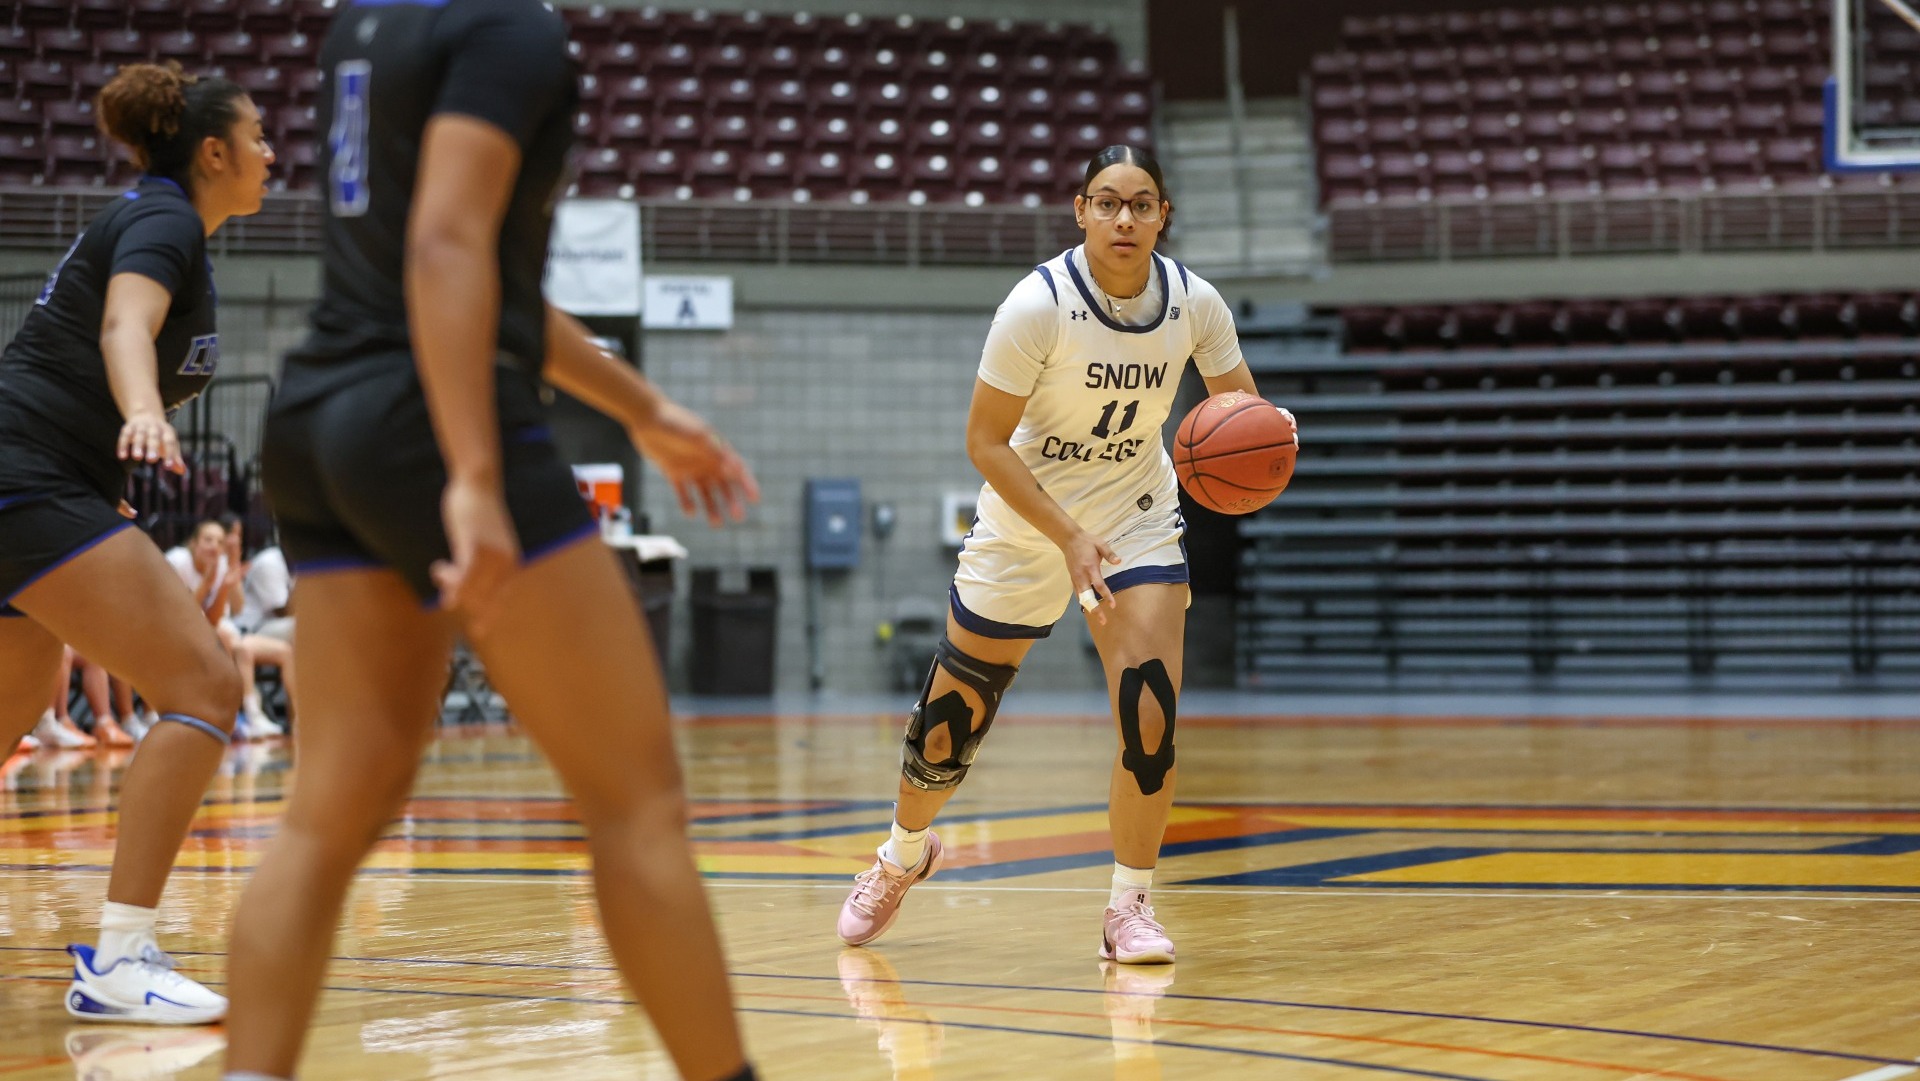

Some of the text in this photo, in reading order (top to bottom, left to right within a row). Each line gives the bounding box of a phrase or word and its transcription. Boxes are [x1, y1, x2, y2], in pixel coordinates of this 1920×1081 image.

[1085, 362, 1168, 390] SNOW
[1090, 400, 1140, 440] 11
[1041, 436, 1145, 462] COLLEG
